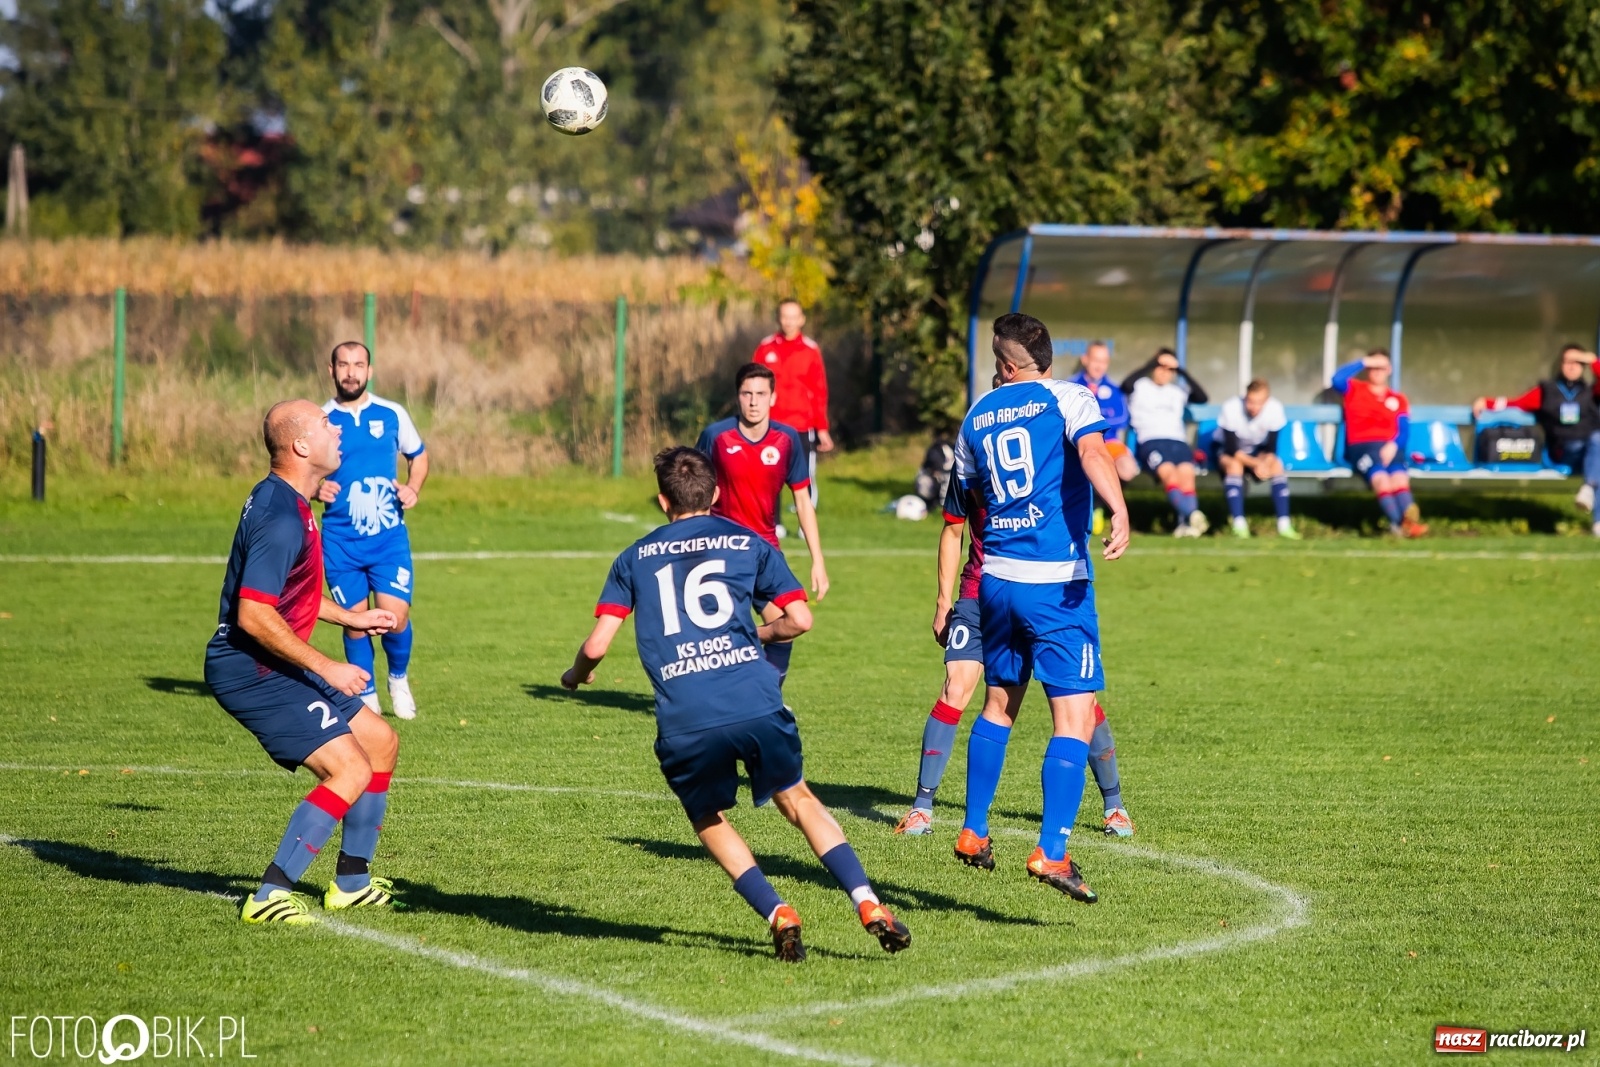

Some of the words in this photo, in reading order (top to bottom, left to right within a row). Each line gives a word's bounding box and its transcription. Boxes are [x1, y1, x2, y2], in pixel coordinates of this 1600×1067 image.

[973, 410, 995, 432] UNIA
[982, 426, 1035, 504] 19
[638, 535, 751, 560] HRYCKIEWICZ
[654, 559, 734, 637] 16
[676, 641, 696, 660] KS
[699, 635, 733, 656] 1905
[660, 645, 760, 682] KRZANOWICE
[306, 700, 339, 730] 2
